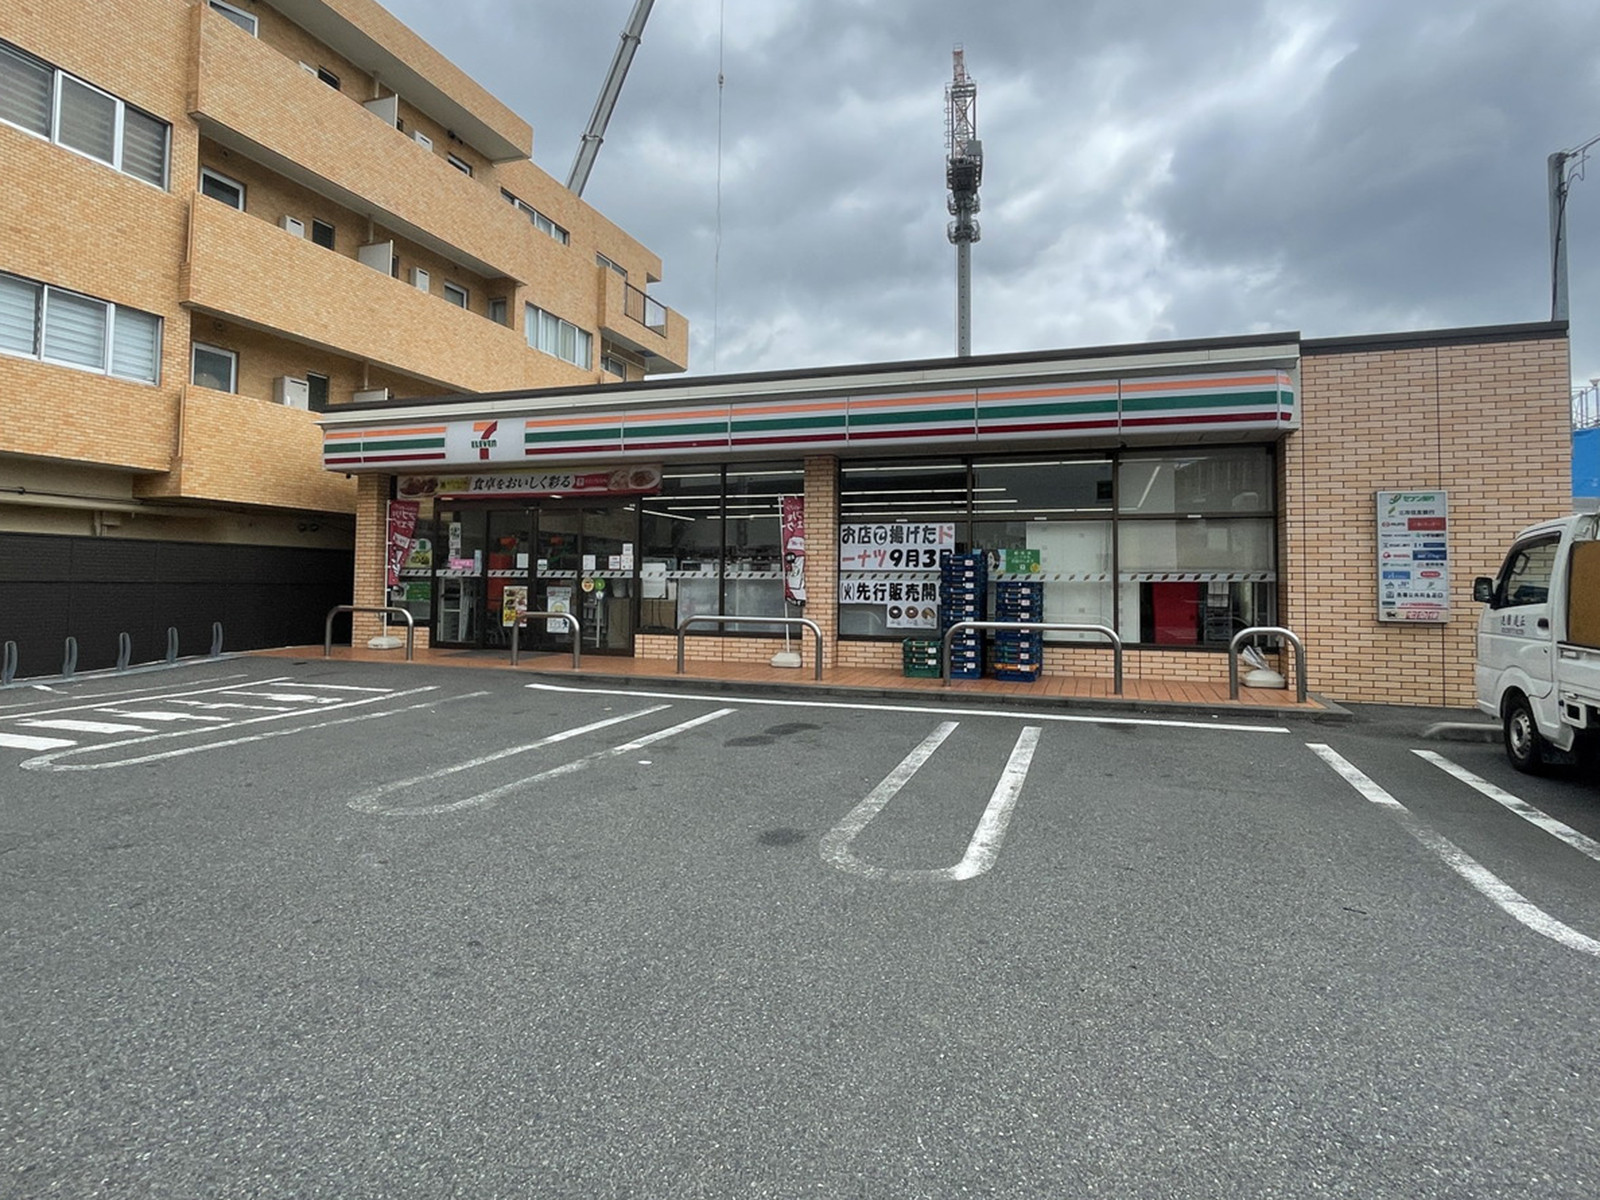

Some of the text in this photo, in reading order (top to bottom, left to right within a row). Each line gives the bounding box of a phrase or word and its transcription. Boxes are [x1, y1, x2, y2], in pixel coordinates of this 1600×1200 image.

[473, 420, 498, 460] 7
[473, 475, 571, 491] 食卓をおいしく彩る
[842, 525, 953, 545] お店で揚げたド
[842, 549, 953, 568] ーナツ9月3
[841, 583, 941, 603] (火)先行販売開
